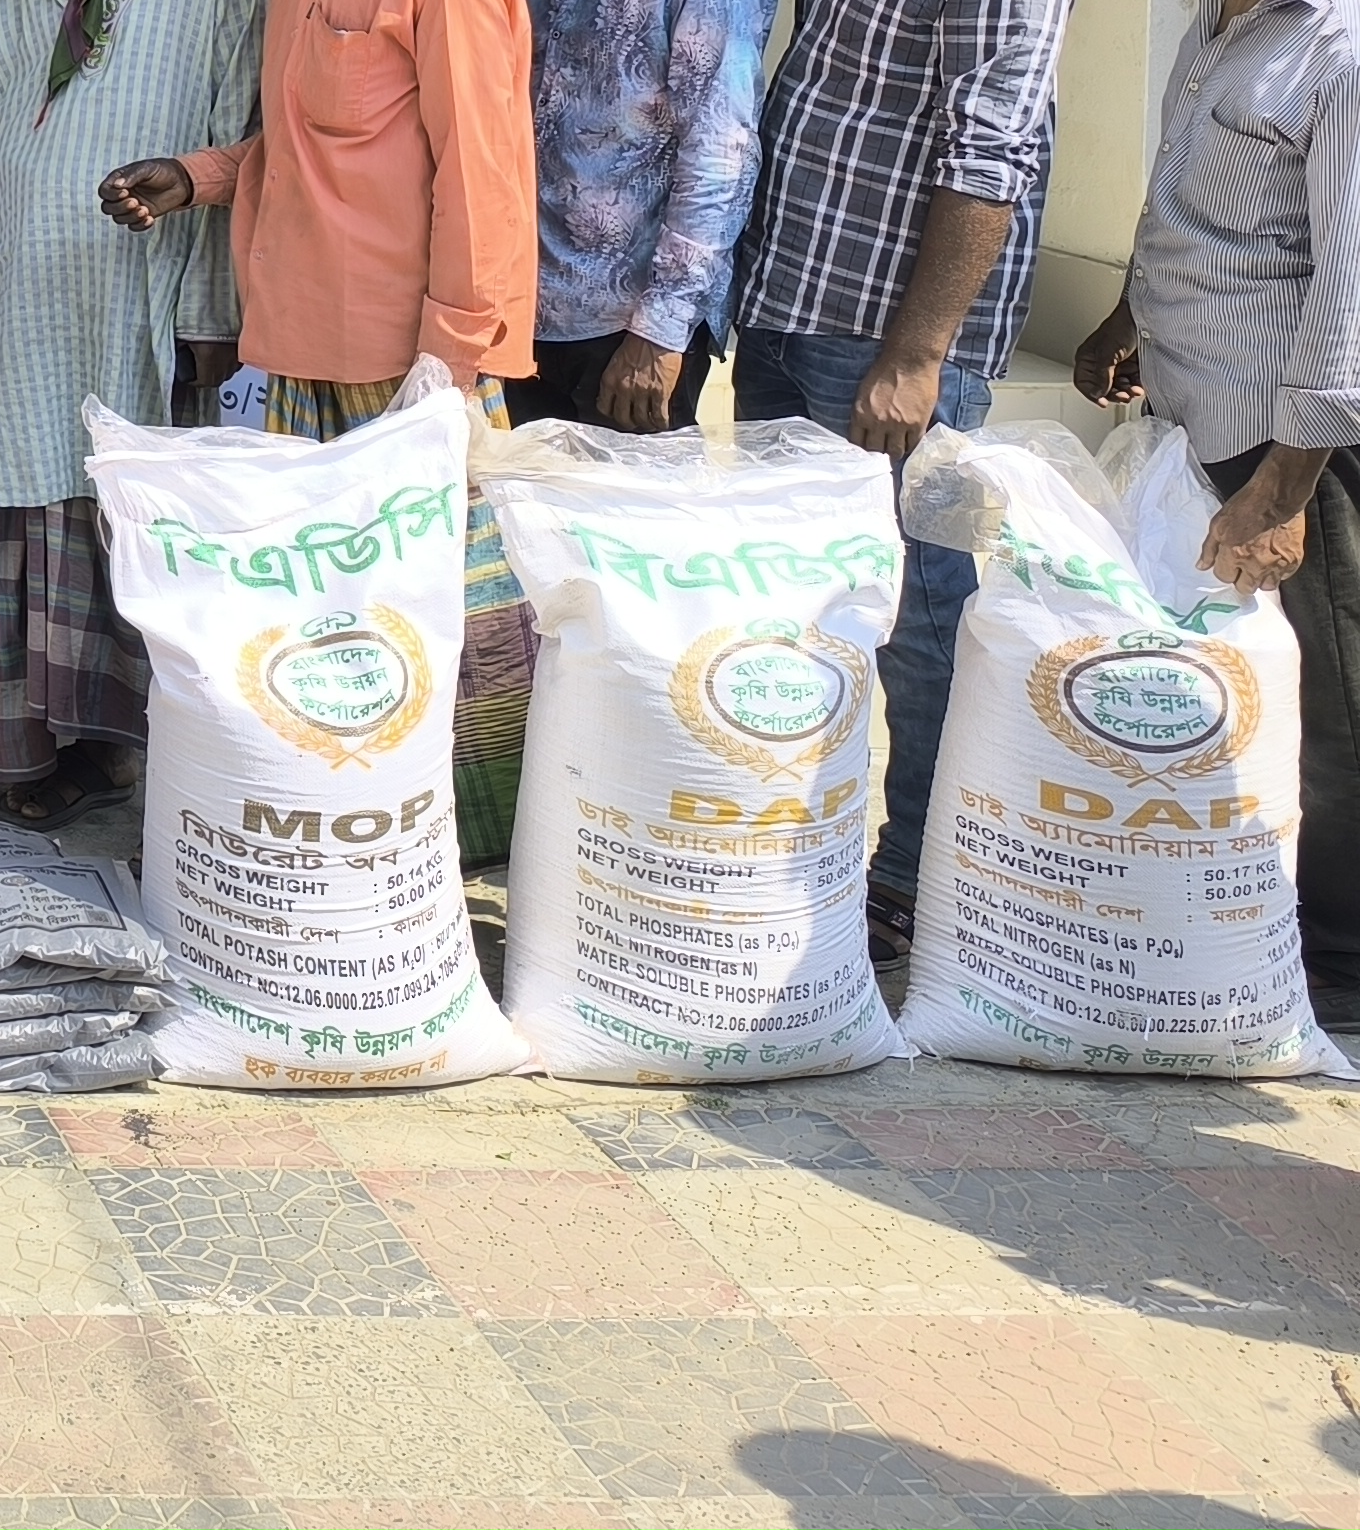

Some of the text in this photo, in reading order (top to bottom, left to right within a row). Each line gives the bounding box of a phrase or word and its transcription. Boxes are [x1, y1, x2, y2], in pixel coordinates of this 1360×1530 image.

[1090, 686, 1202, 715] কৃষি উন্নয়ন
[1095, 663, 1199, 692] বাংলাদেশ
[1093, 706, 1209, 740] কর্পোরেশন
[242, 789, 434, 844] MOP
[576, 797, 635, 839] ডাই
[669, 777, 858, 828] DAP
[958, 785, 1219, 859] ডাই অ্যামোনিয়াম
[1040, 779, 1260, 831] DAP
[175, 838, 241, 880] GROSS
[245, 870, 330, 896] WEIGHT
[177, 809, 402, 872] মিউরেট অব
[577, 827, 657, 865] GROSS
[663, 855, 757, 878] WEIGHT
[577, 844, 720, 894] NET WEIGHT
[955, 814, 1280, 882] GROSS WEIGHT 50.17 KG.
[955, 831, 1280, 901] NET WEIGHT 50.00 KG.
[29, 886, 48, 895] তিল
[175, 857, 425, 913] NET WEIGHT 50.00
[175, 876, 293, 938] উৎপাদনকারী
[300, 926, 342, 944] দেশ
[1096, 903, 1145, 923] দেশ
[576, 890, 760, 954] TOTAL PHOSPHATES (as
[954, 877, 1138, 952] TOTAL PHOSPHATES (as
[956, 901, 1136, 980] TOTAL NITROGEN (as N)
[177, 908, 396, 981] TOTAL POTASH CONTENT (AS
[180, 941, 252, 985] CONTRACT
[576, 915, 758, 981] TOTAL NITROGEN (as N)
[576, 939, 630, 975] WATER
[635, 963, 709, 998] SOLUBLE
[714, 982, 810, 1005] PHOSPHATES
[576, 968, 674, 1018] CONTTRACT
[958, 948, 1049, 1006] CONTTRACT
[1011, 951, 1086, 992] SOLUBLE
[1091, 978, 1197, 1006] PHOSPHATES
[1201, 990, 1222, 1010] (as
[186, 979, 417, 1060] বাংলাদেশ কৃষি উন্নয়ন
[957, 983, 1219, 1069] বাংলাদেশ কৃষি উন্নয়ন
[283, 1066, 353, 1086] ব্যবহার
[360, 1063, 425, 1083] করবেন
[700, 1042, 752, 1071] কৃষি
